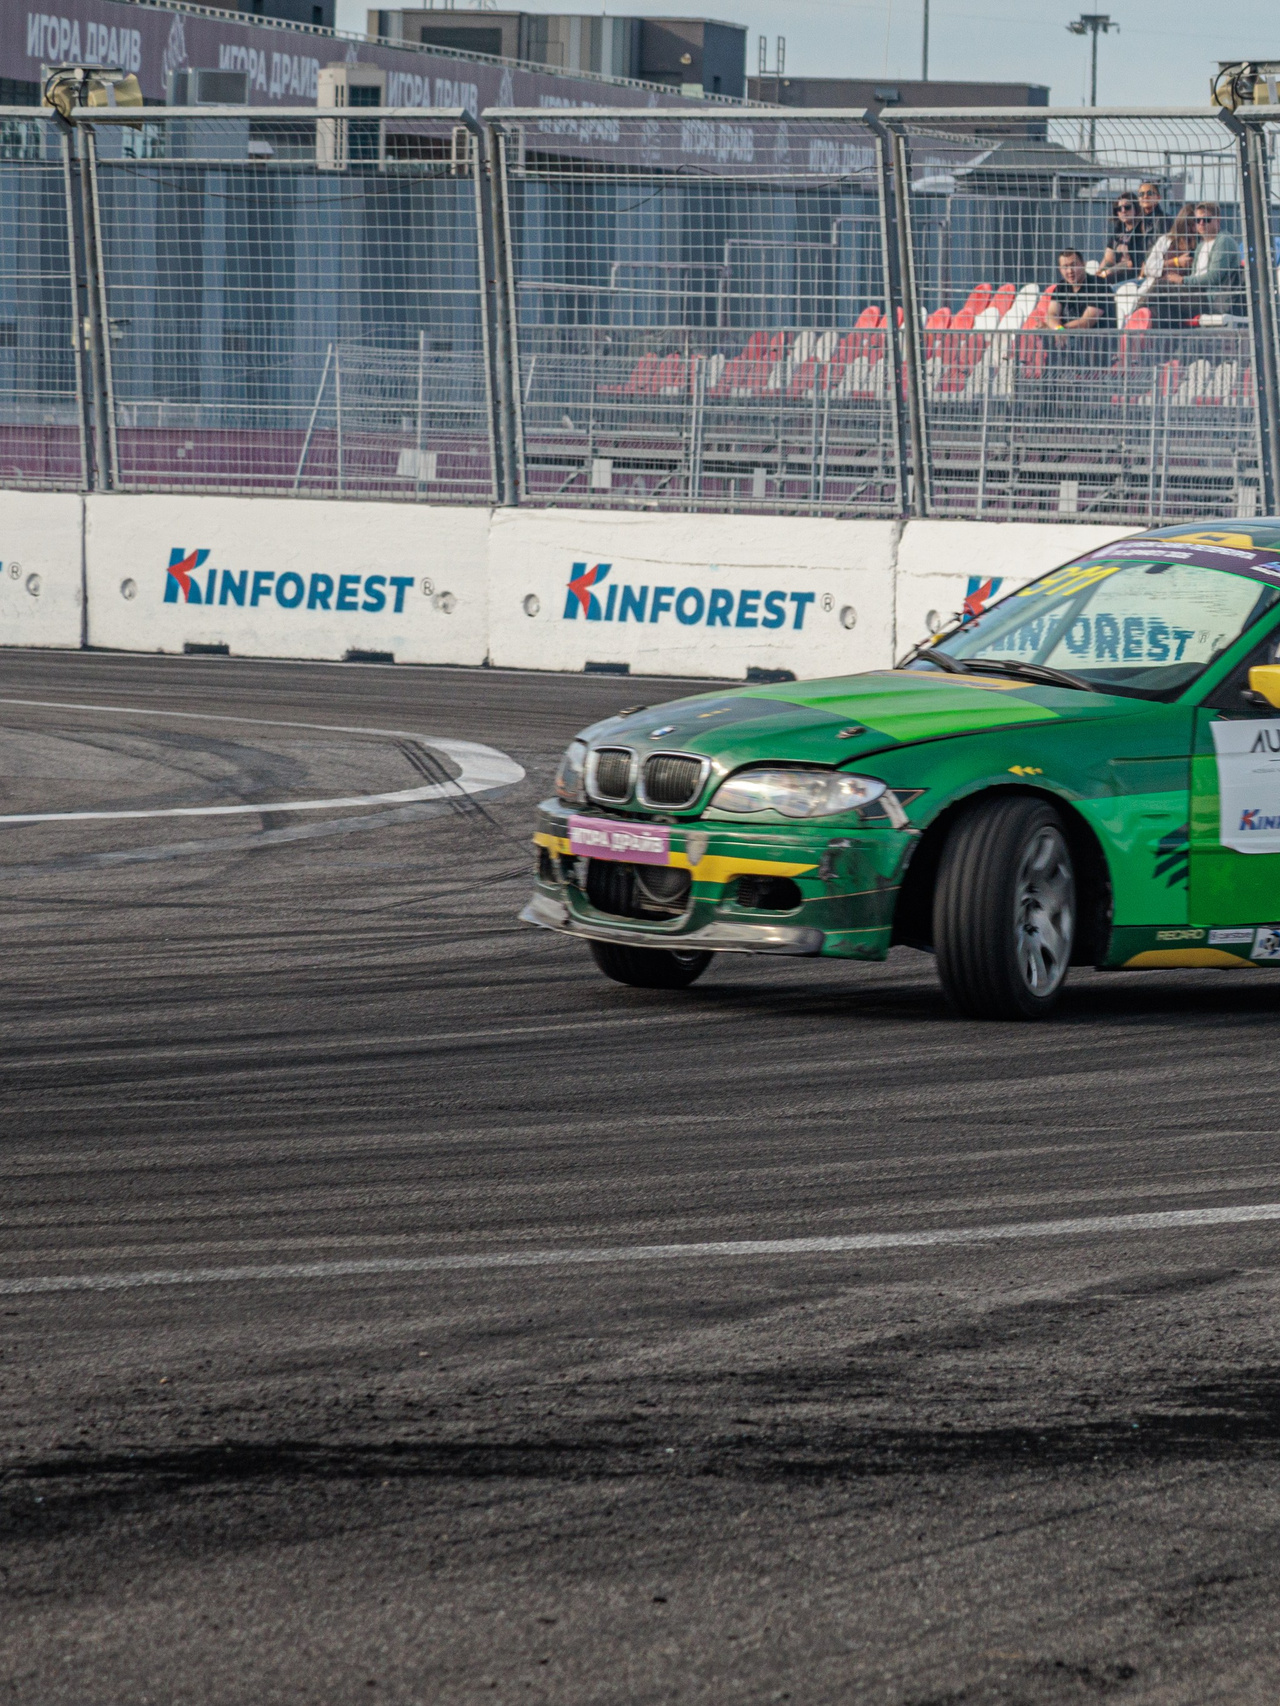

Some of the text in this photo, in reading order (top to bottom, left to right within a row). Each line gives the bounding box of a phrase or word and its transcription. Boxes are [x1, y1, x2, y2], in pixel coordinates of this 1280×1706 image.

[27, 12, 82, 63] ИГОРА
[164, 548, 414, 613] KINFOREST
[563, 562, 815, 630] KINFOREST
